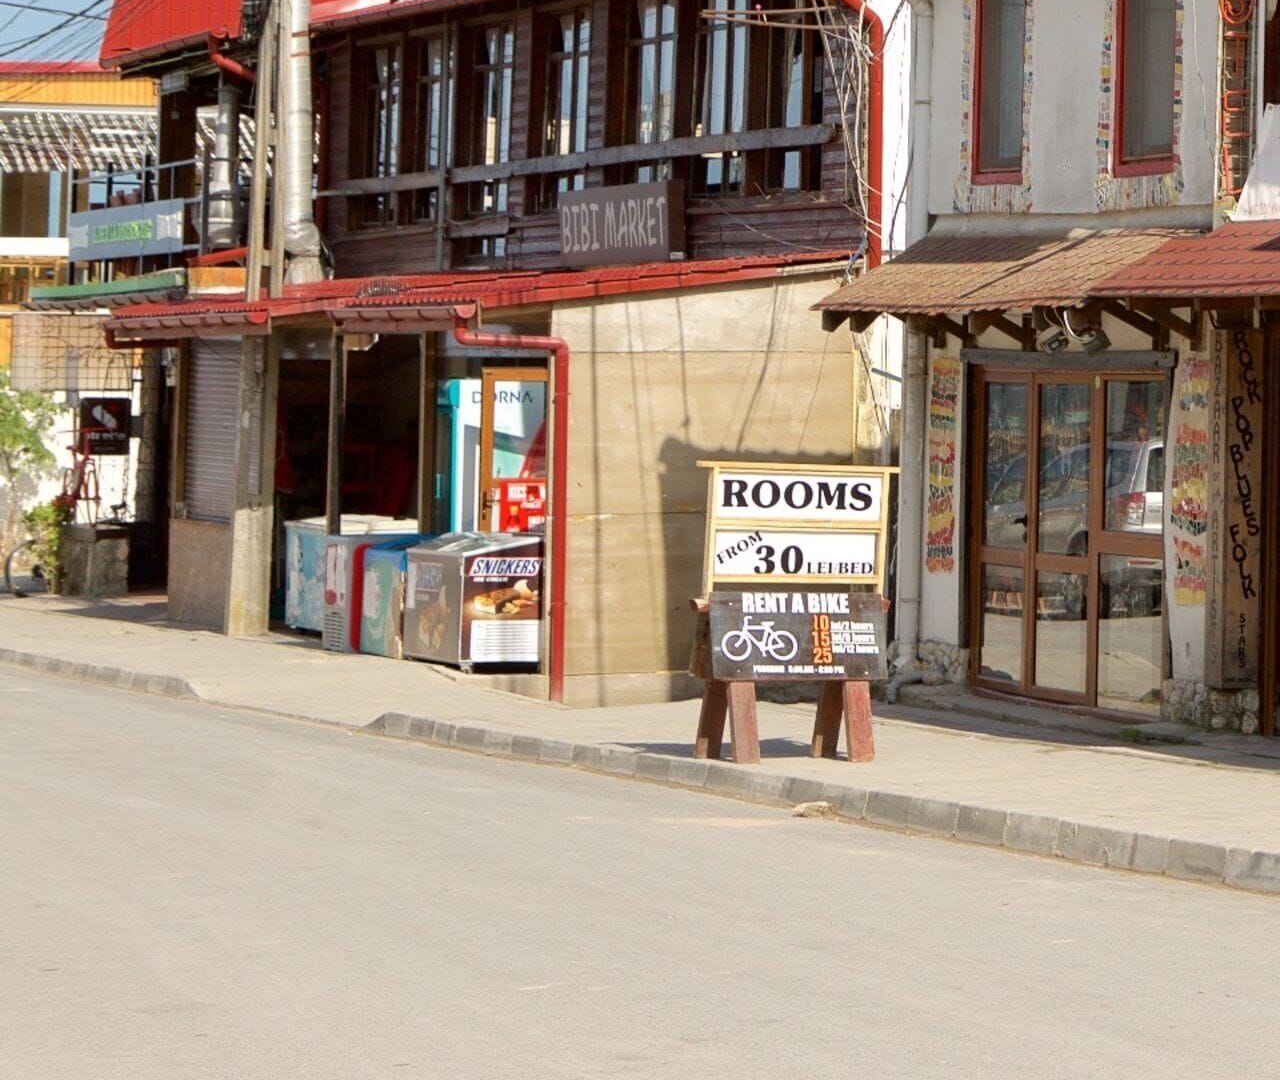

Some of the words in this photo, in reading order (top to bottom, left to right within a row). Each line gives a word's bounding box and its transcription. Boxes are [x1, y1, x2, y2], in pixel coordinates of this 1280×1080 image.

[562, 203, 600, 254] BIBI
[604, 196, 666, 250] MARKET
[1233, 330, 1261, 404] ROCK
[472, 390, 534, 404] DRNA
[1212, 334, 1223, 464] BAZAAR
[1231, 395, 1254, 451] POP
[721, 479, 873, 511] ROOMS
[1229, 444, 1260, 536] BLUES
[716, 530, 764, 565] FROM
[753, 545, 804, 575] 30
[1229, 524, 1256, 600] FOLK
[473, 559, 540, 576] SNICKERS
[742, 592, 788, 614] RENT
[792, 593, 805, 614] A
[807, 593, 850, 614] BIKE
[811, 631, 831, 647] 15
[813, 614, 830, 631] 10
[813, 647, 833, 664] 25
[1237, 613, 1246, 669] STARS
